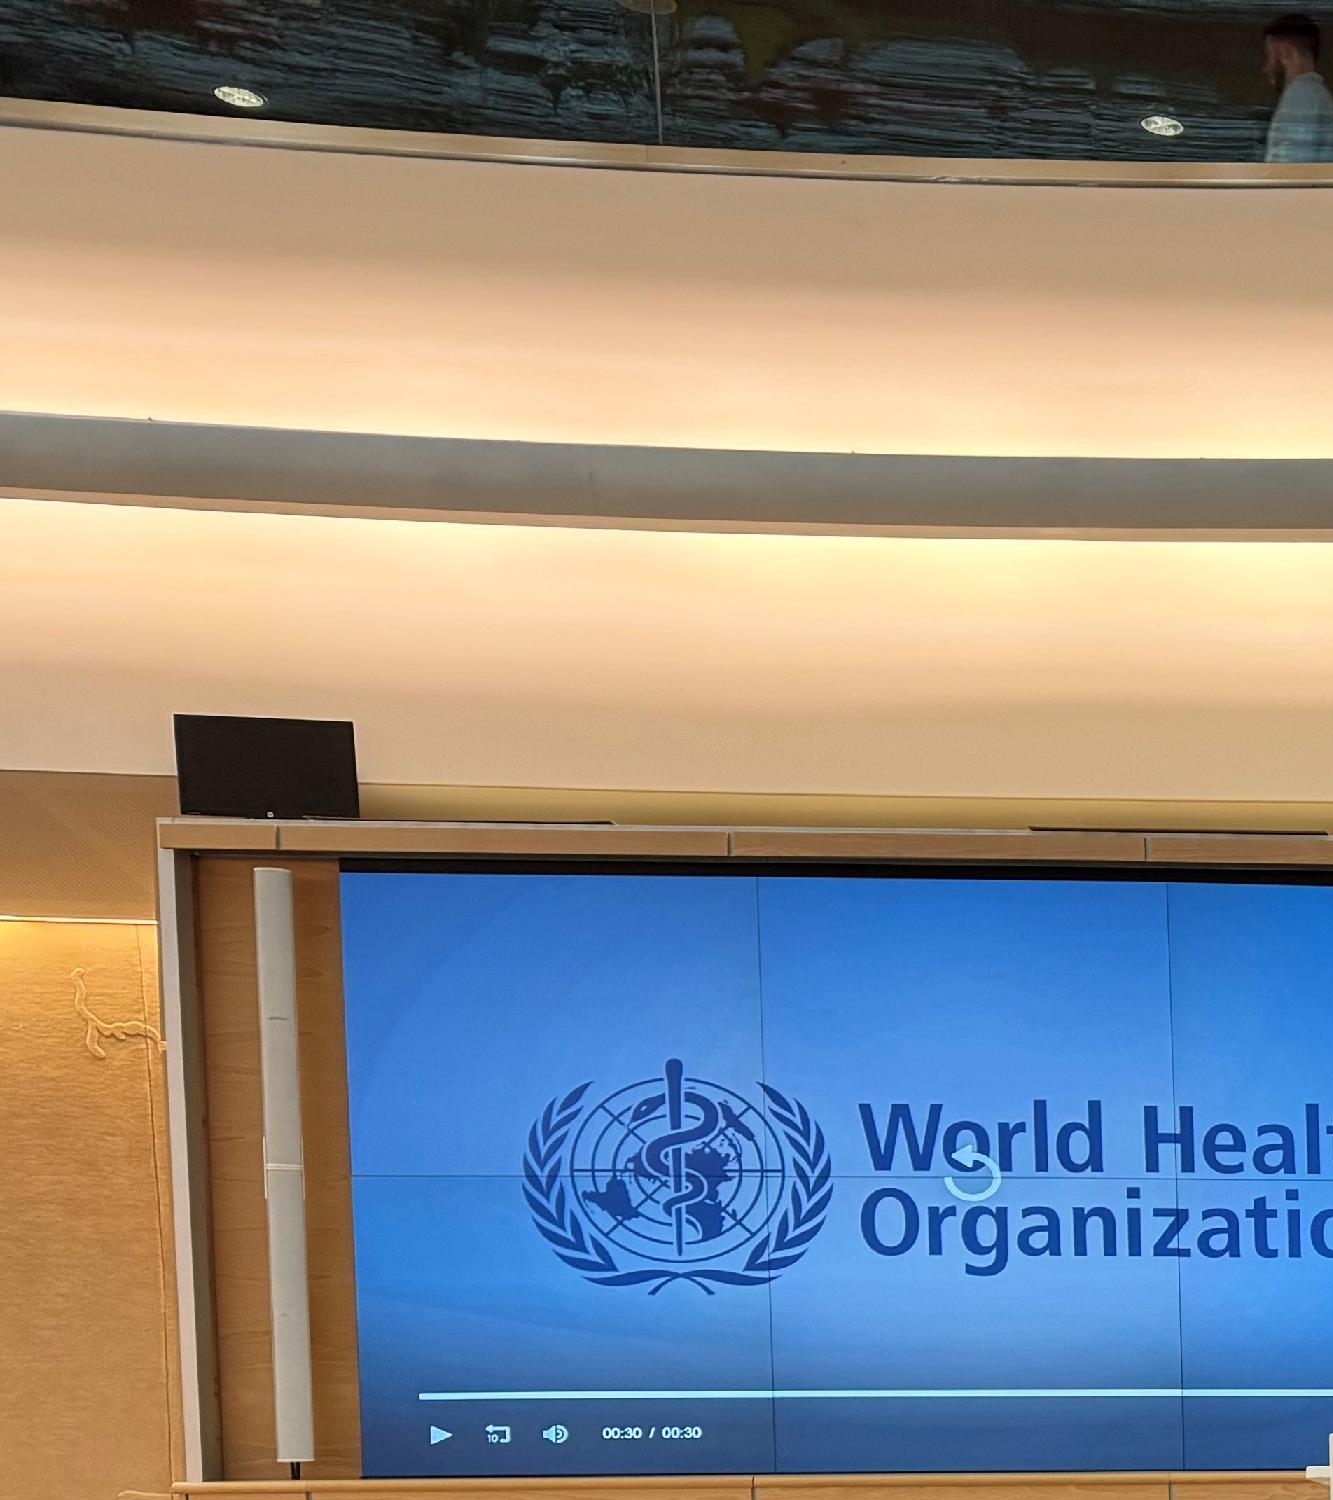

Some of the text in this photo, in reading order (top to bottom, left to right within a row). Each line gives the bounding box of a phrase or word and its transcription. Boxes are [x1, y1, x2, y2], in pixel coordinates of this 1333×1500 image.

[858, 1100, 1104, 1173] World
[602, 1427, 702, 1440] 00:30 / 00:30
